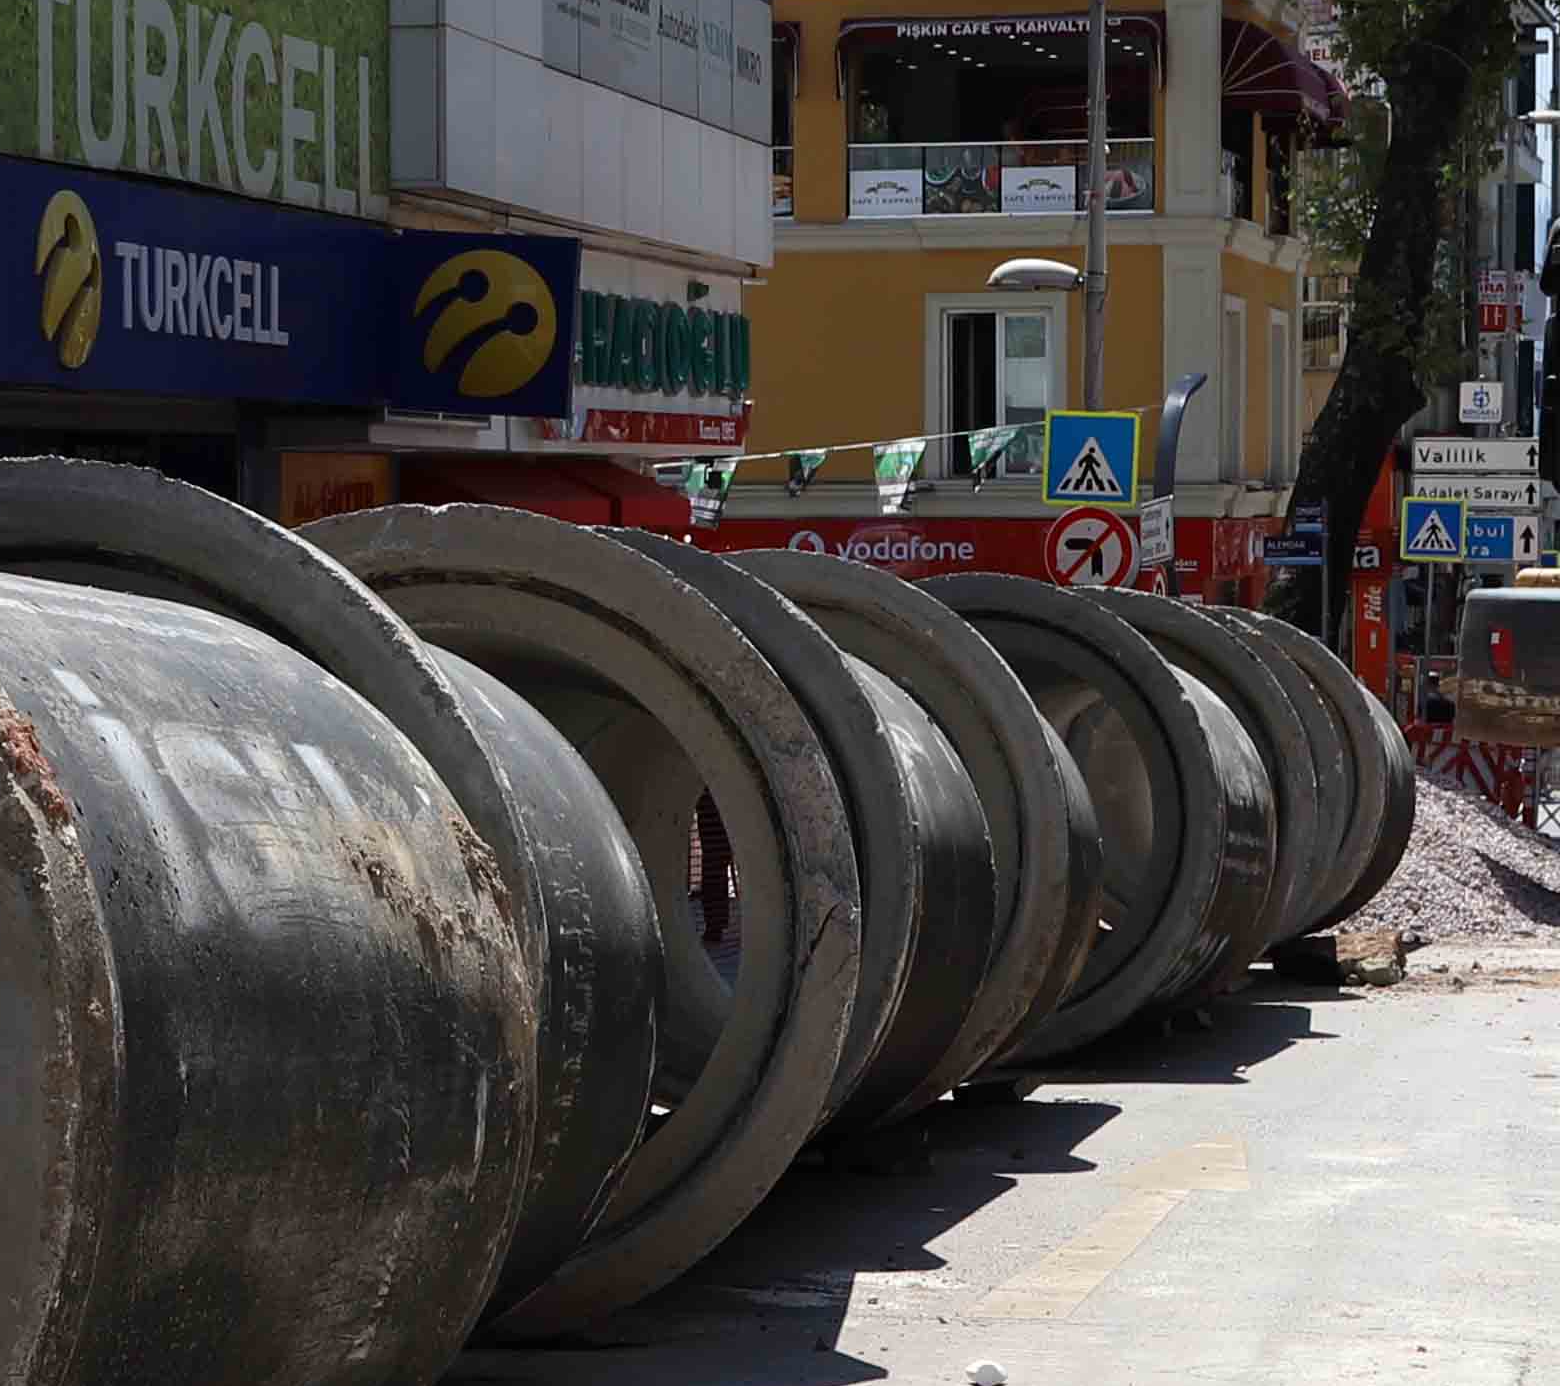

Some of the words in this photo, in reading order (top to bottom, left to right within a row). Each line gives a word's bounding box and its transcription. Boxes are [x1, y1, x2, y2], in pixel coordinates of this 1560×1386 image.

[952, 21, 991, 36] CAFE
[115, 240, 290, 347] TURKCELL
[1418, 447, 1487, 465] Valilik
[1416, 485, 1469, 502] Adalet
[1473, 485, 1523, 505] Sarayı
[837, 533, 975, 563] vodafone
